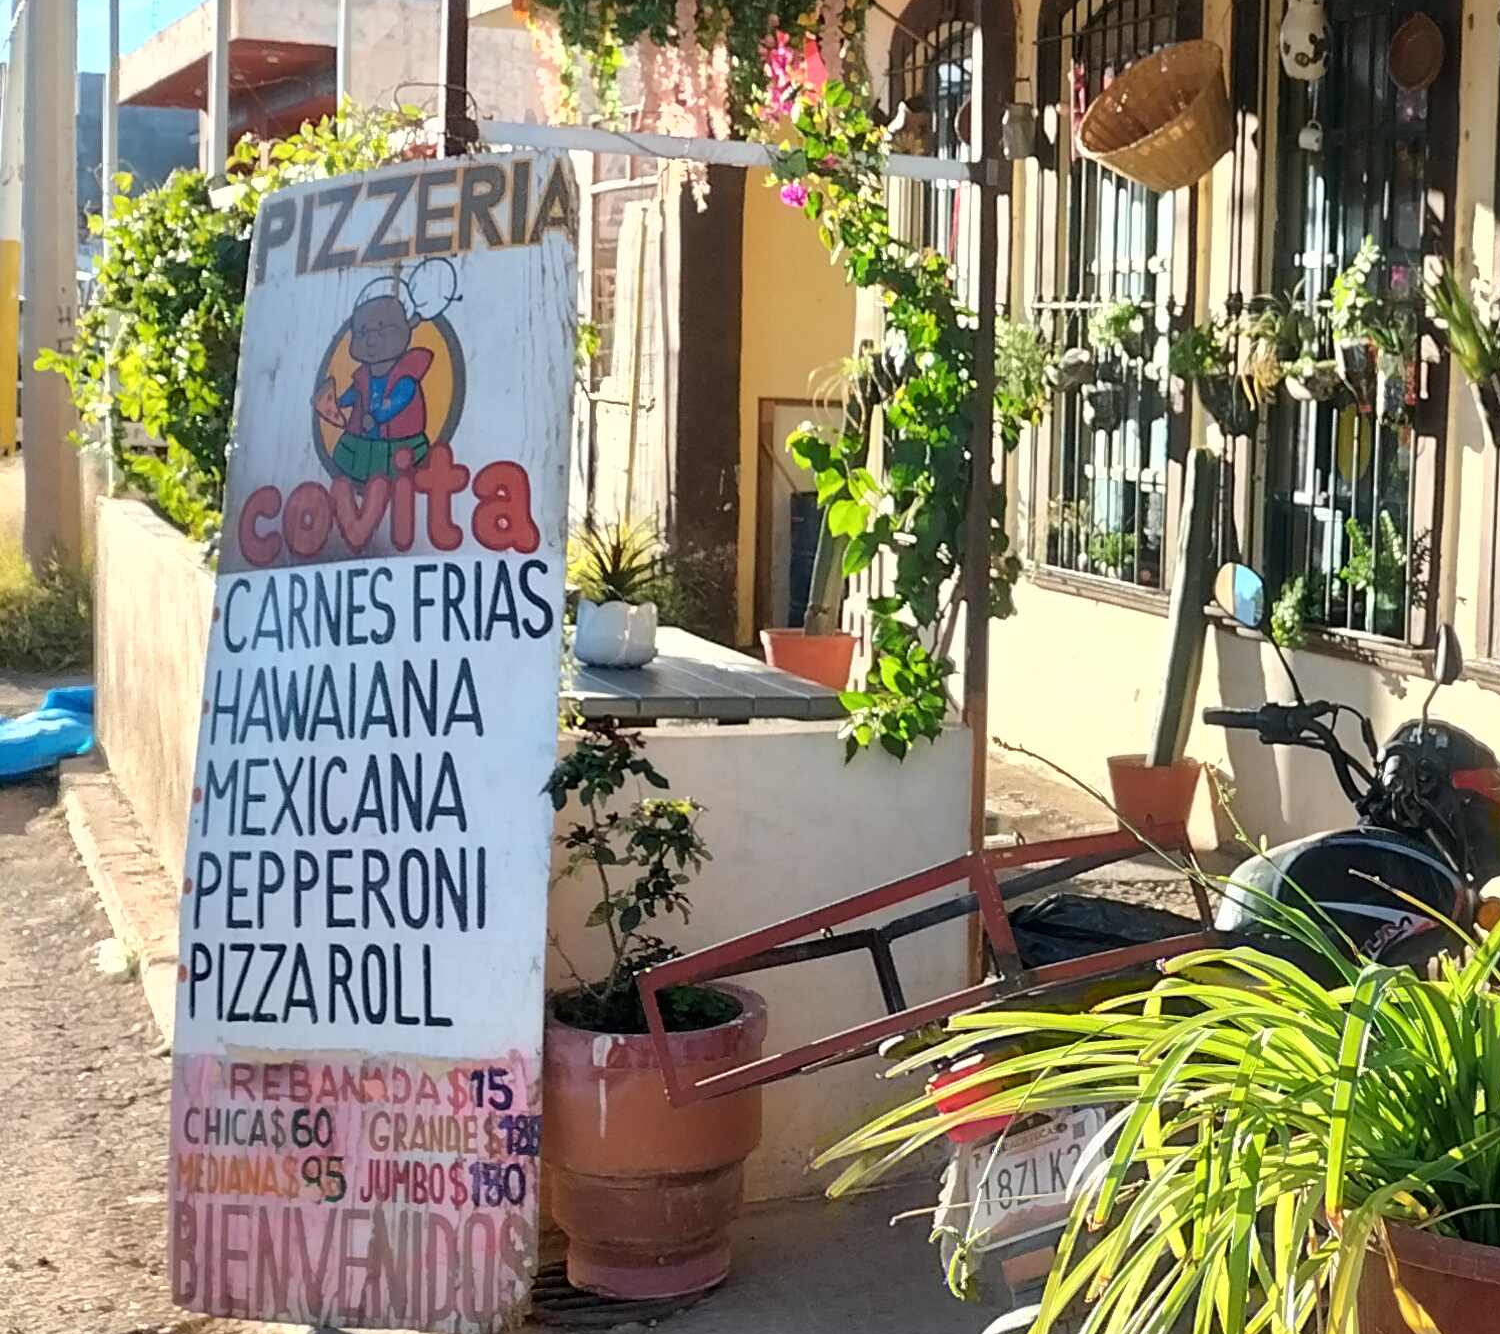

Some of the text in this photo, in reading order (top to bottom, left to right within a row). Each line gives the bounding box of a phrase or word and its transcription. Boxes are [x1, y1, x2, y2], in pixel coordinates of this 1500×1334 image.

[255, 157, 579, 286] PIZZERIA
[238, 441, 541, 567] covita
[223, 559, 554, 653] CARNES FRIAS
[210, 657, 485, 745] HAWAIANA
[201, 751, 468, 837] MEXICANA
[193, 846, 487, 932] PEPPERONI
[187, 942, 454, 1027] PIZZA ROLL
[229, 1060, 442, 1106] REBANADA
[369, 1110, 478, 1155] GRANDE
[360, 1159, 446, 1205] JUMBO
[171, 1201, 537, 1325] BIENVENIDOS
